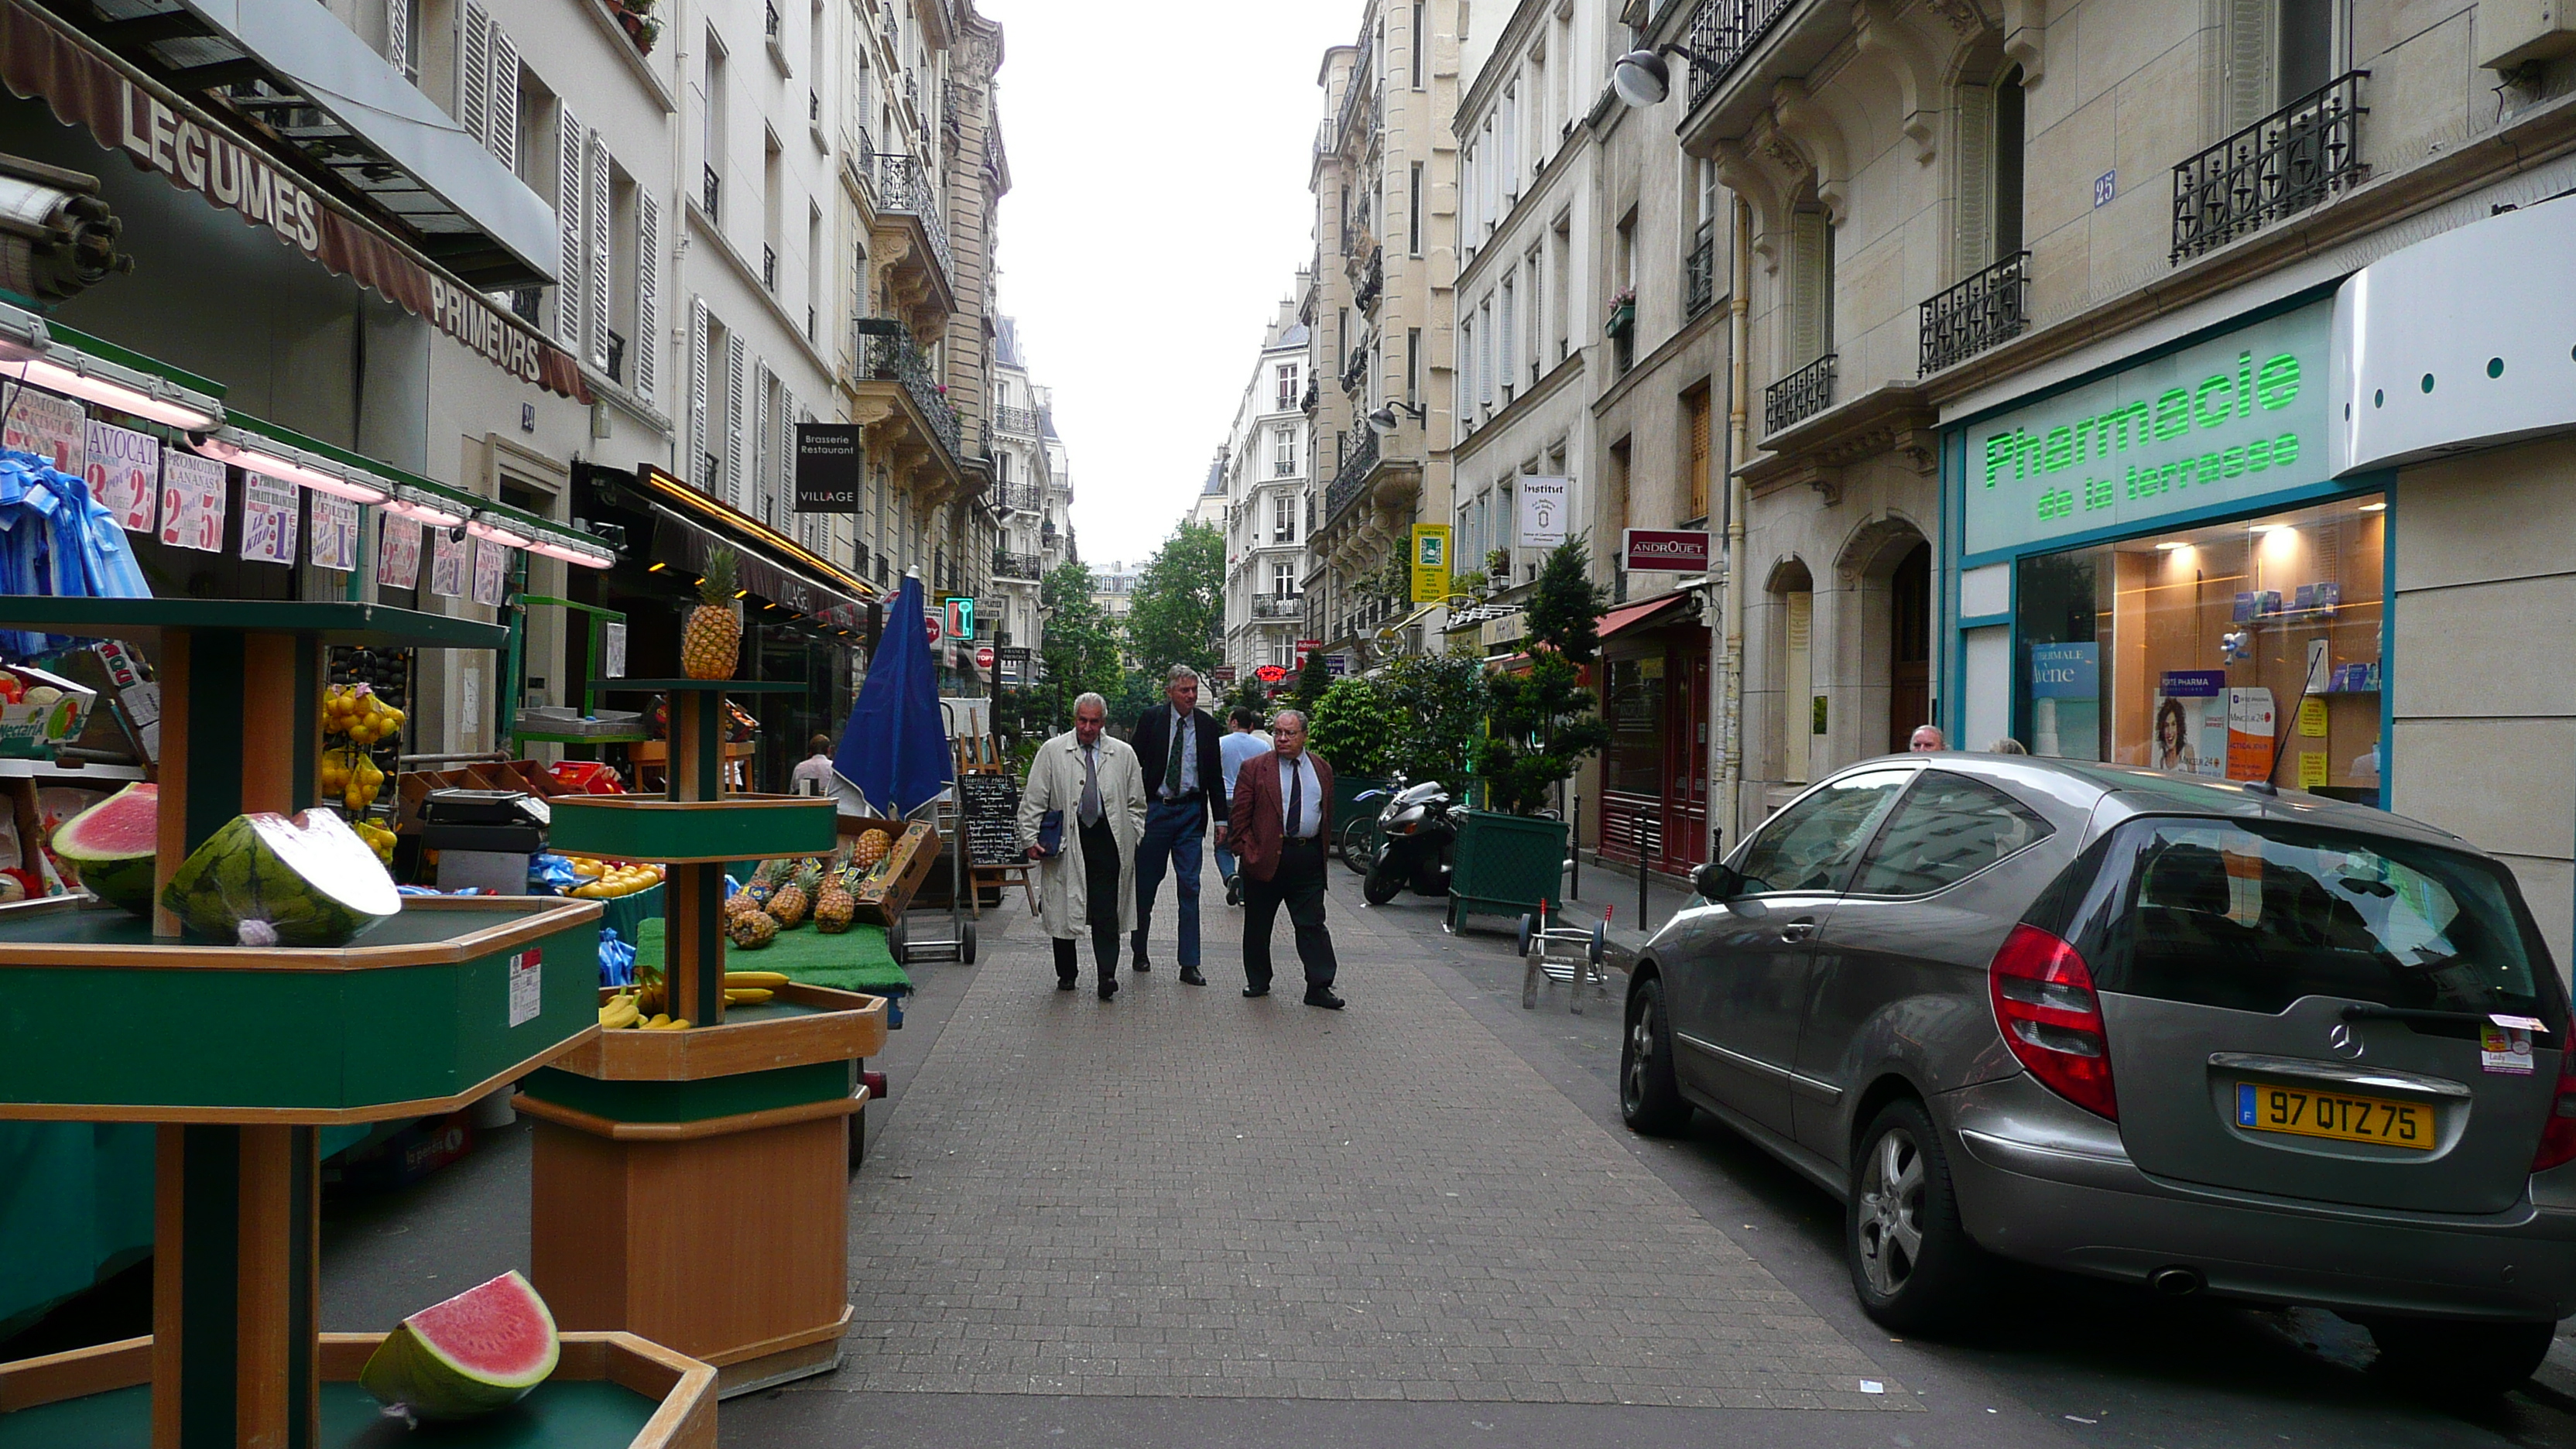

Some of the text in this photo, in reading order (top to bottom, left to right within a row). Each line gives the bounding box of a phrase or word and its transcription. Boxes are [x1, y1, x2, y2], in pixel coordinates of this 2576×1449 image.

[121, 79, 320, 252] LEGUMES
[2096, 173, 2113, 206] 25
[430, 276, 541, 382] PRIMEURS
[1986, 350, 2301, 490] Pharmacie
[88, 426, 156, 465] AVOCAT
[801, 445, 853, 454] Restaurant
[805, 435, 849, 444] Brasserie
[168, 453, 224, 476] PROMOTION
[2038, 433, 2299, 522] de la terrasse
[87, 463, 106, 505] 3
[128, 468, 146, 529] 2
[177, 471, 215, 491] ANANAS
[1524, 483, 1563, 494] Institut
[320, 502, 350, 519] FILET
[800, 492, 854, 502] VILLAGE
[163, 488, 182, 544] 2
[200, 494, 215, 549] 5
[253, 513, 266, 531] LE
[245, 526, 270, 553] KILO
[274, 512, 286, 560] 1
[337, 524, 348, 567] 1
[1633, 541, 1703, 553] ANDROUET
[2177, 678, 2209, 687] PHARMA
[2245, 1091, 2416, 1139] F 97 QTZ 75
